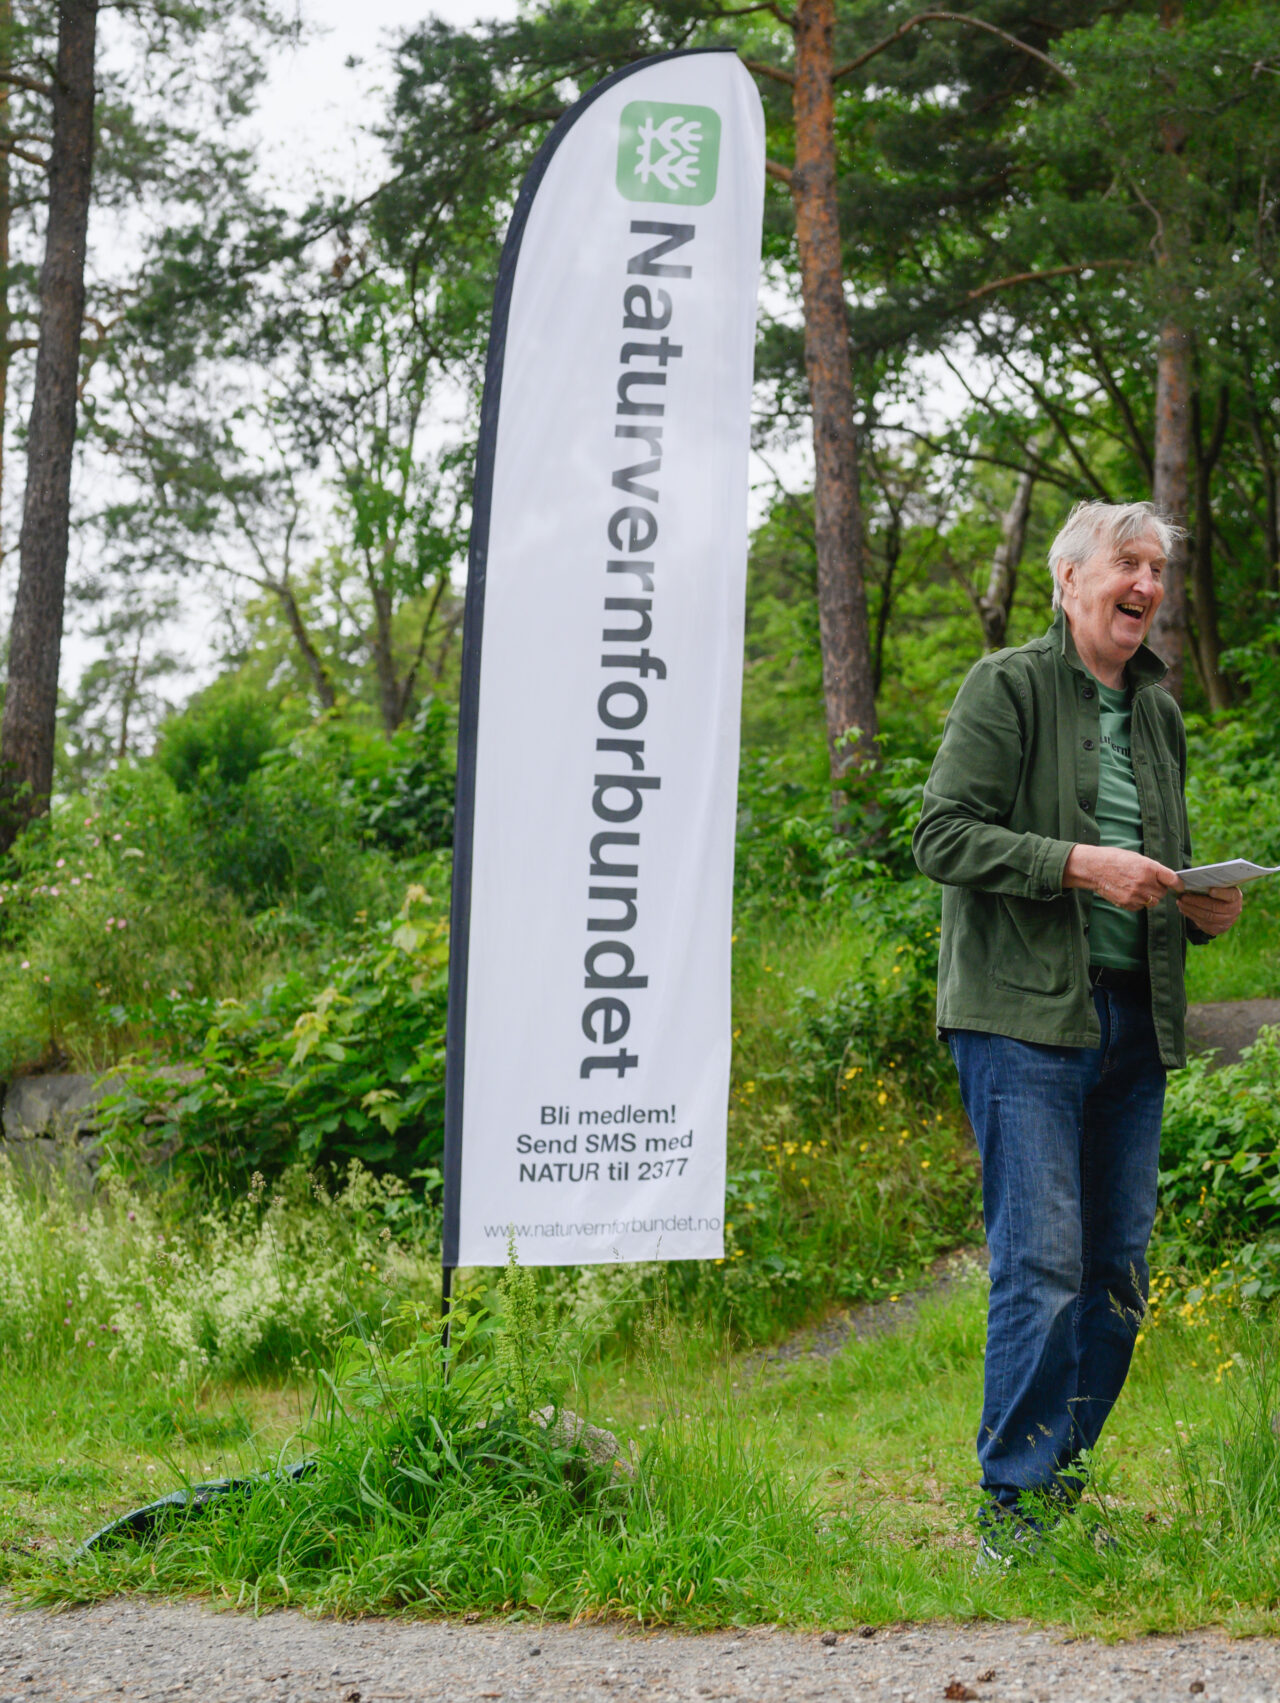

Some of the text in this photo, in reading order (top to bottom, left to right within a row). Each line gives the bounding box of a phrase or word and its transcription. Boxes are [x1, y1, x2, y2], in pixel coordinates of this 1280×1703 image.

[580, 220, 696, 1079] Naturvernforbundet
[540, 1104, 677, 1125] Bli medlem!
[516, 1129, 693, 1155] Send SMS med
[519, 1157, 689, 1182] NATUR til 2377
[484, 1215, 721, 1238] www.naturvernforbundet.no
